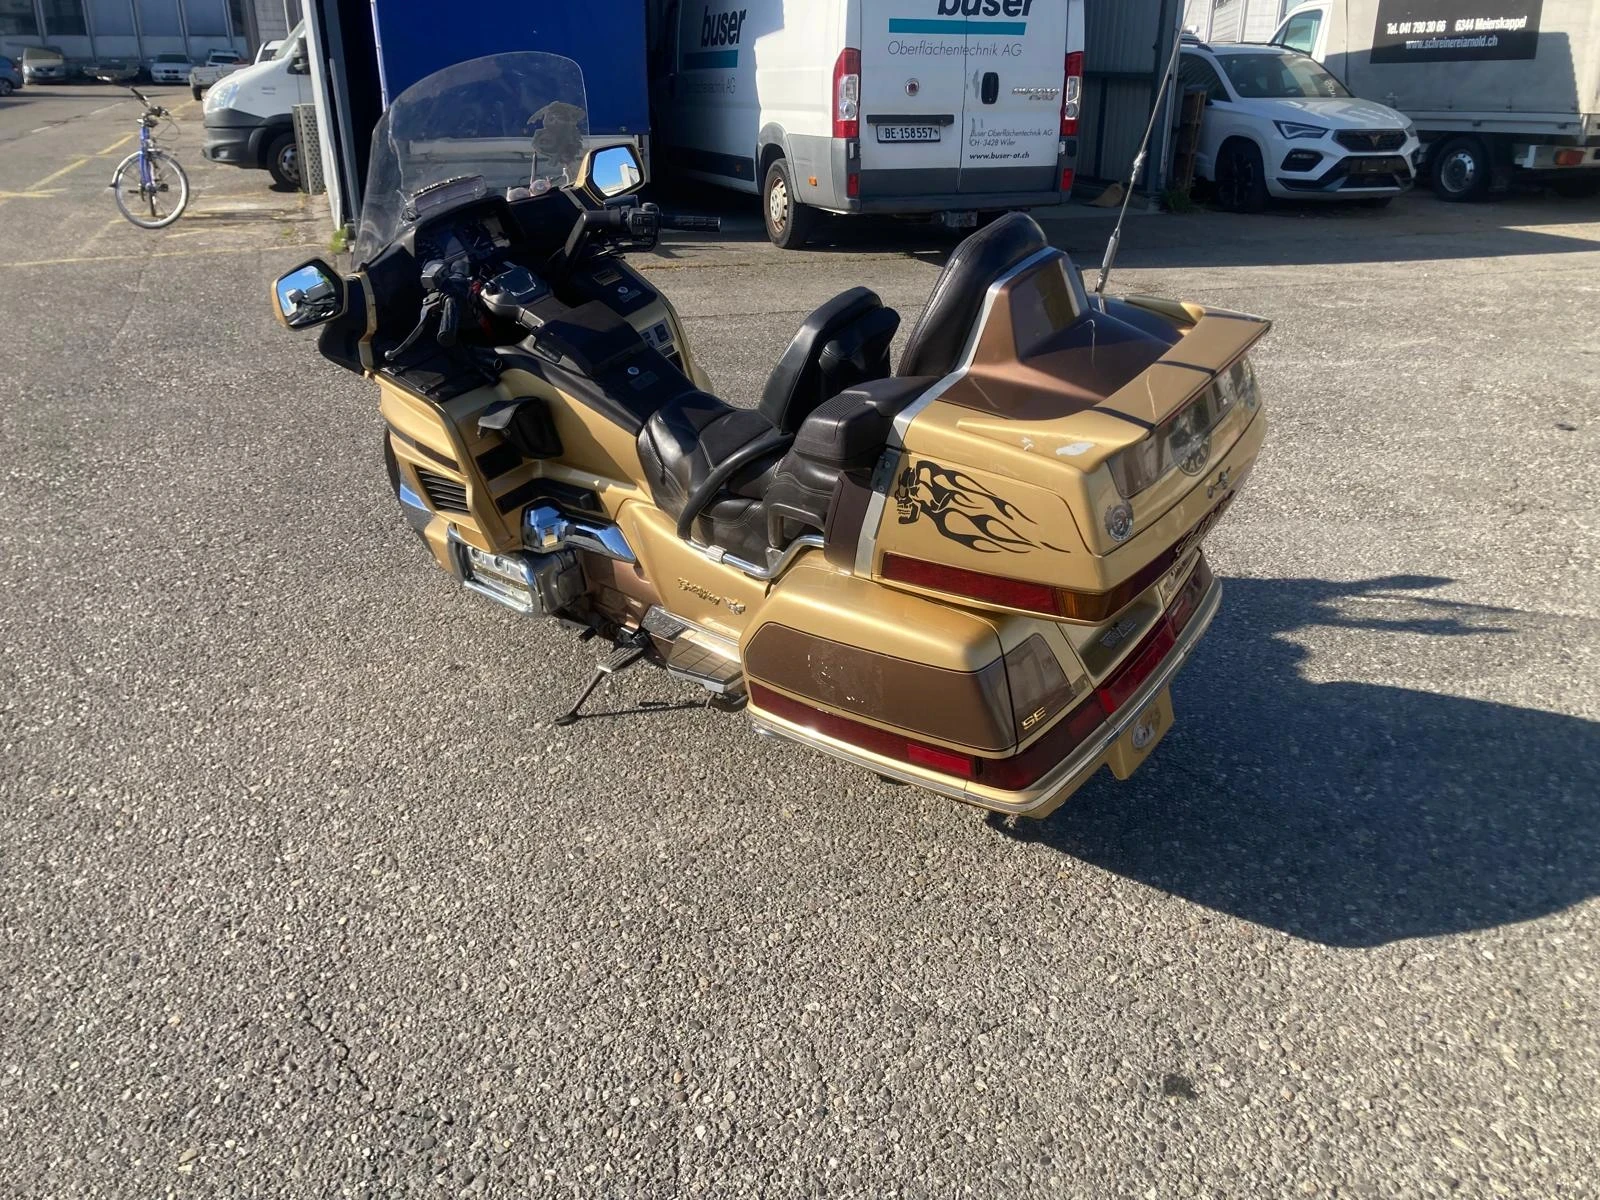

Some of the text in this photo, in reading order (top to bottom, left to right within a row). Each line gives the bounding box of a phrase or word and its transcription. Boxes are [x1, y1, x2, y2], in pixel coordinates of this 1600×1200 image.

[702, 5, 747, 47] buser
[1387, 22, 1398, 34] Tel.
[1399, 21, 1411, 33] 041
[1455, 15, 1528, 31] 6344 Meierskappel
[888, 40, 1022, 56] Oberflächentechnik AG
[1042, 129, 1053, 137] AG
[1021, 706, 1047, 730] SE
